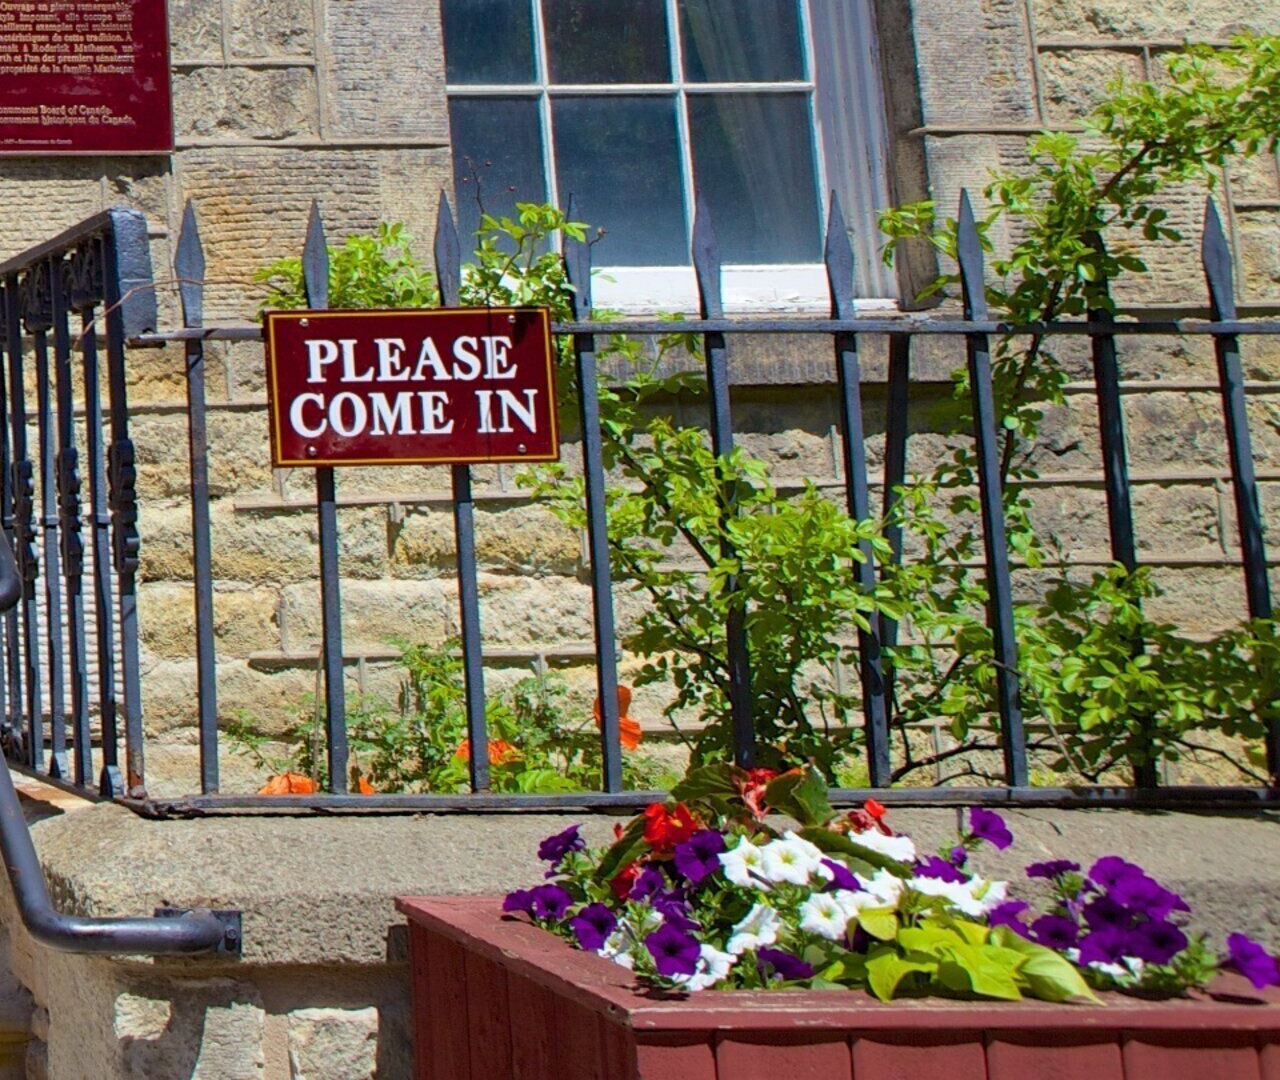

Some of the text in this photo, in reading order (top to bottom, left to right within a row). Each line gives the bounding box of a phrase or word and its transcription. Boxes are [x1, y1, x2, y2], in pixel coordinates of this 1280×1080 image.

[305, 336, 517, 382] PLEASE
[290, 389, 537, 438] COME IN
